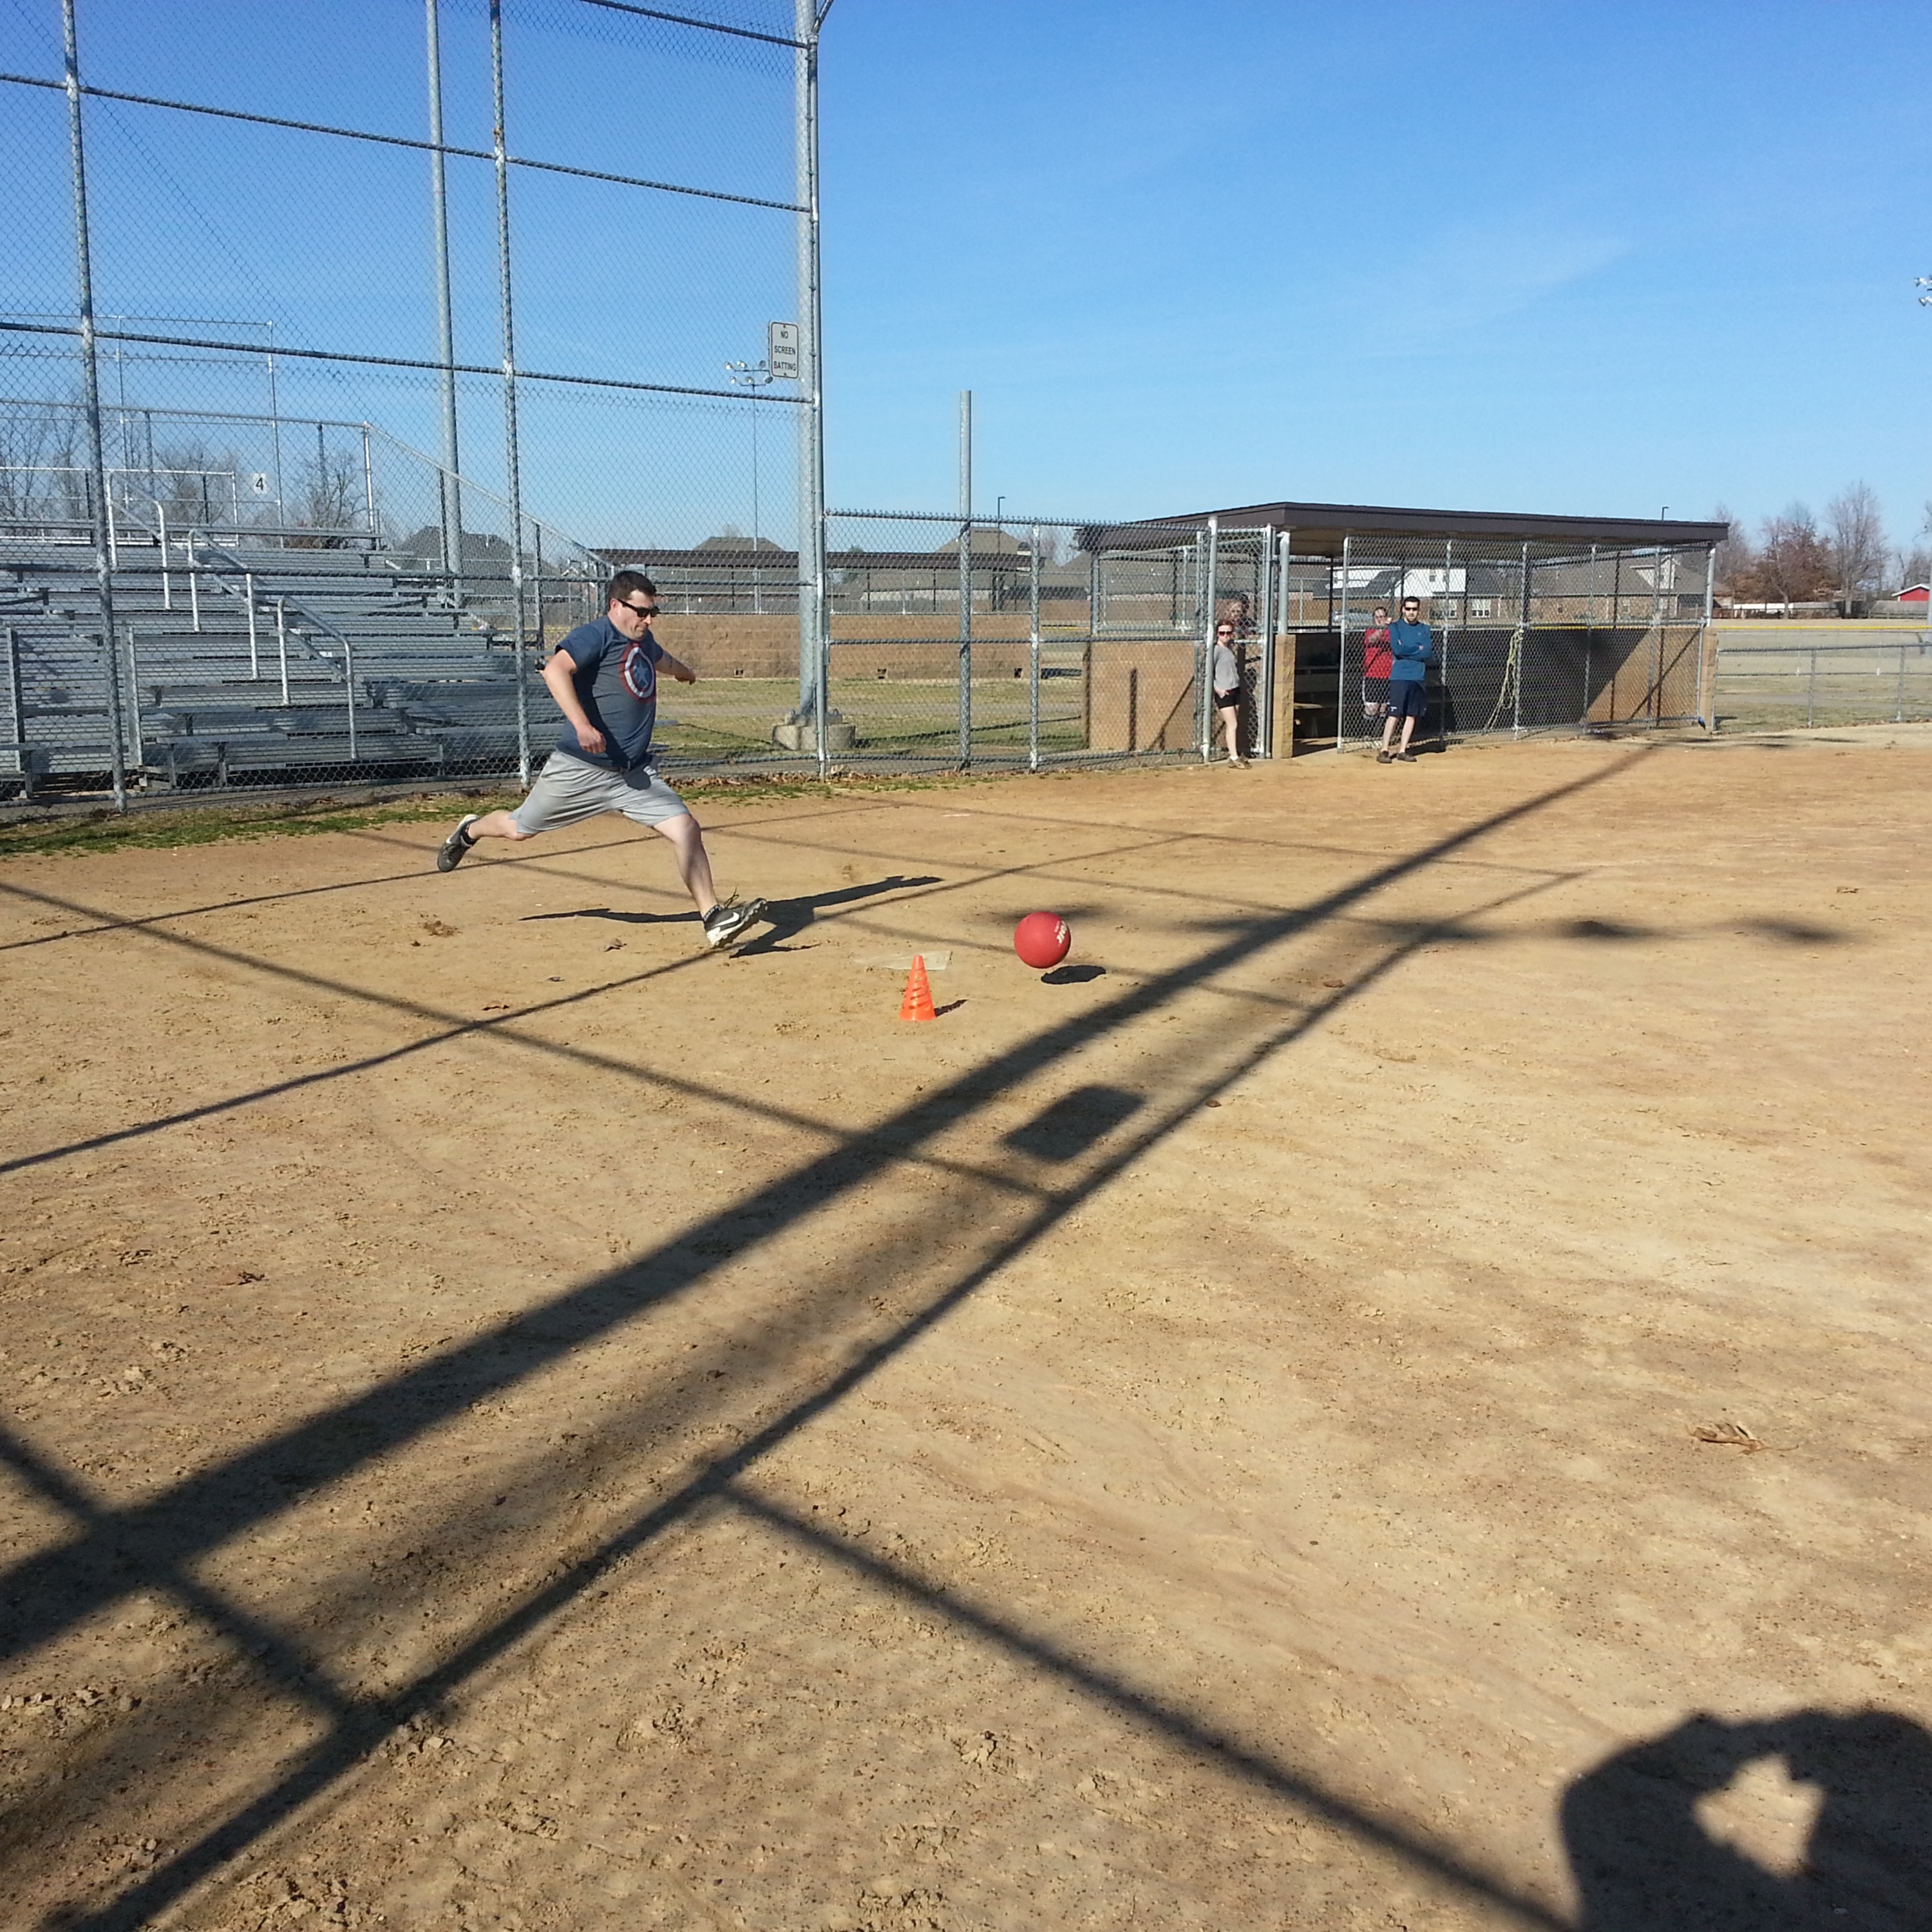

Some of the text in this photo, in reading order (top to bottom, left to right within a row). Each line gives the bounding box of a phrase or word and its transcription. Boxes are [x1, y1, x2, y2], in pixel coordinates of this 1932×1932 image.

[781, 330, 789, 339] NO
[774, 345, 796, 355] SCREEN
[773, 361, 797, 372] BATTING
[255, 477, 264, 491] 4
